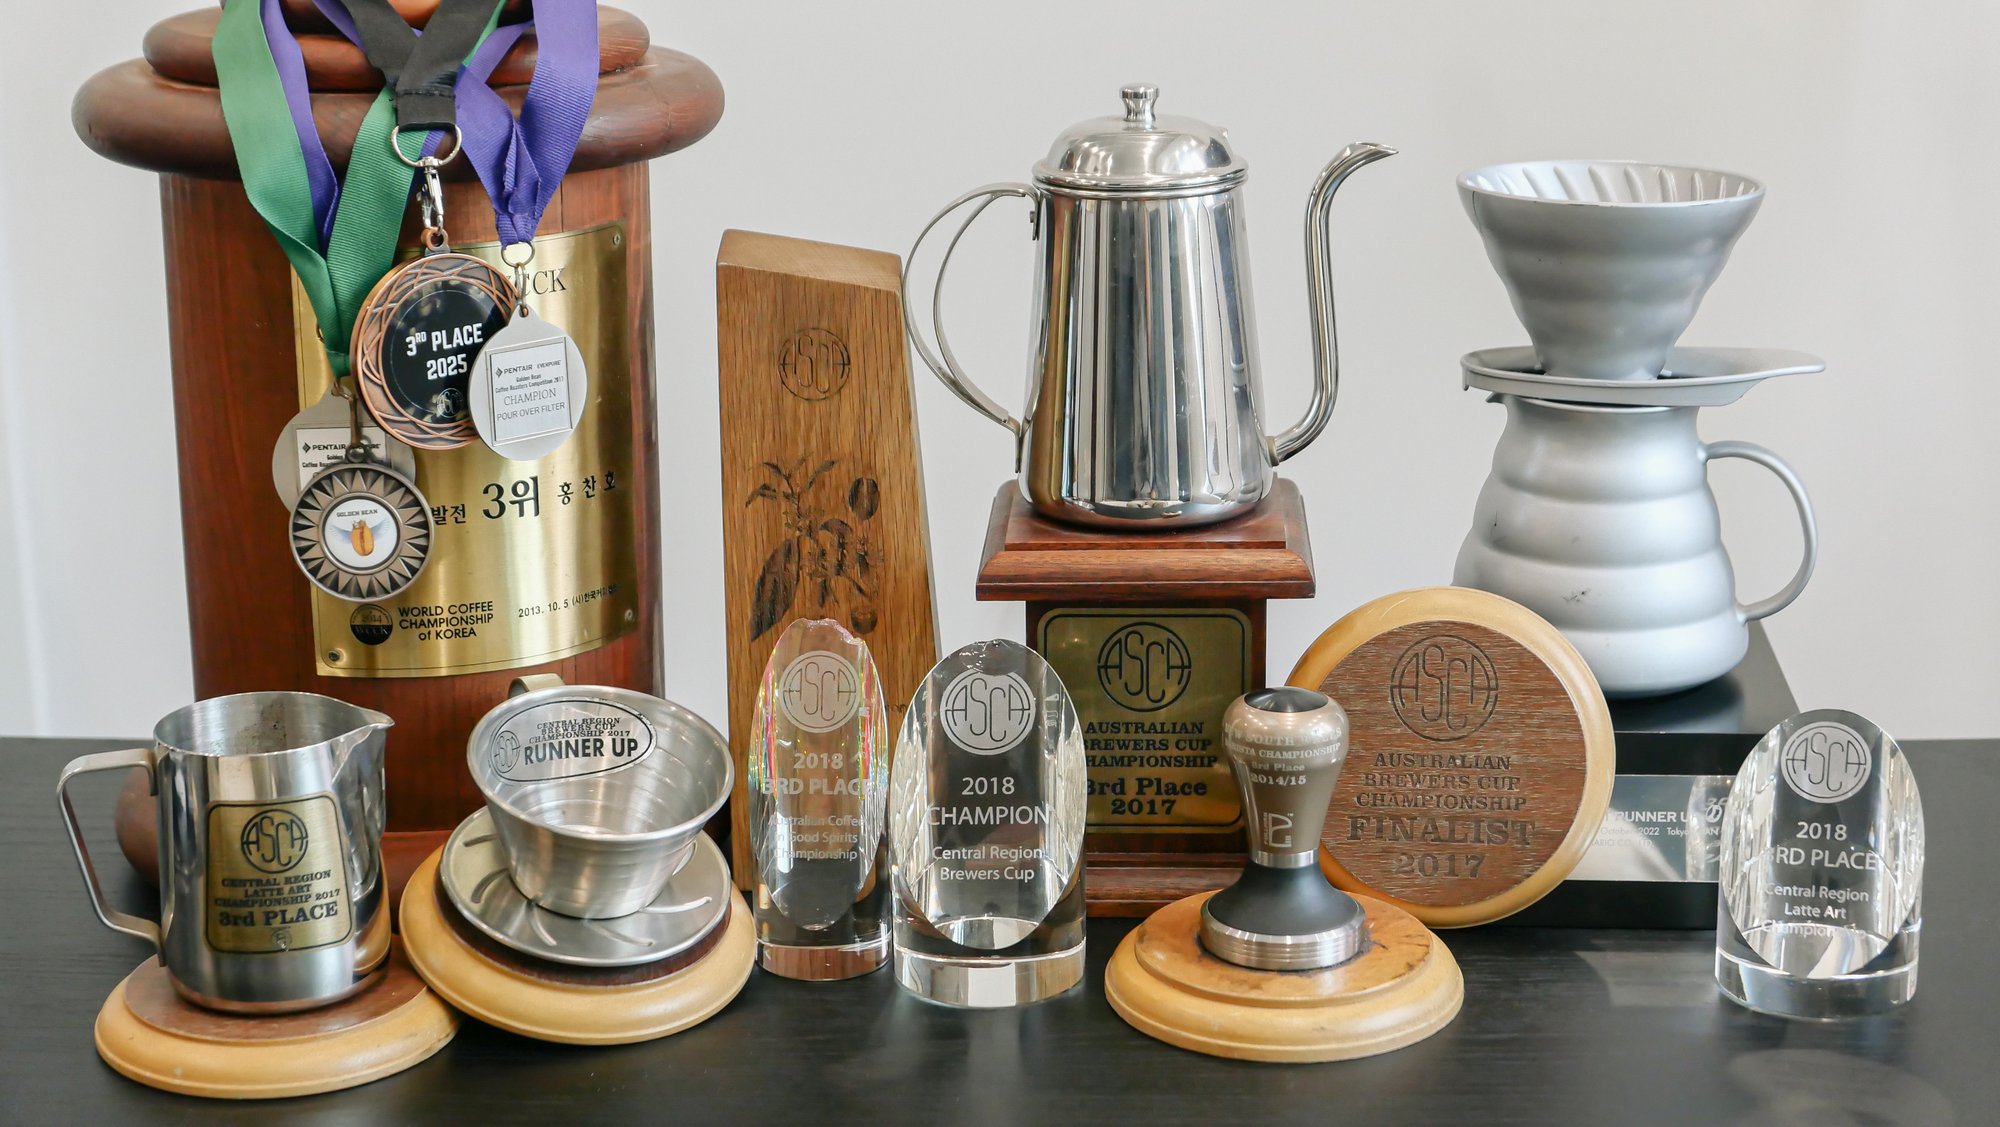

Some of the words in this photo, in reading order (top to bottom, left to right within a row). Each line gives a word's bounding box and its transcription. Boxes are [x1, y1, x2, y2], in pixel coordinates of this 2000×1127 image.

[431, 323, 484, 352] PLACE
[426, 353, 468, 380] 2025
[504, 364, 533, 374] PENTAIR
[504, 388, 556, 406] CHAMPION
[496, 411, 518, 421] POUR
[519, 407, 540, 417] OVER
[541, 402, 565, 412] FILTER
[482, 475, 540, 520] 3위
[398, 605, 444, 618] WORLD
[448, 601, 493, 615] COFFEE
[518, 606, 544, 618] 2013.
[548, 601, 560, 612] 10.
[564, 598, 569, 609] 5
[399, 613, 494, 630] CHAMPIONSHIP
[418, 630, 431, 641] of
[435, 627, 476, 640] KOREA
[1097, 629, 1192, 704] ASCA
[783, 660, 858, 722] ASCA
[1390, 644, 1499, 731] ASCA
[944, 677, 1031, 743] ASCA
[537, 718, 578, 730] CENTRAL
[582, 717, 621, 725] REGION
[541, 724, 592, 736] BREWERS
[595, 723, 616, 731] CUP
[1084, 721, 1205, 734] AUSTRALIAN
[529, 730, 604, 745] CHAMPIONSHIP
[608, 730, 631, 738] 2017
[1174, 738, 1213, 752] CUP
[1246, 733, 1295, 746] SOUTH
[524, 738, 605, 766] RUNNER
[612, 738, 639, 758] UP
[1259, 742, 1341, 759] CHAMPIONSHIP
[793, 752, 844, 770] 2018
[1086, 755, 1218, 768] HAMPIONSHIP
[1274, 762, 1305, 772] Place
[1374, 752, 1512, 771] AUSTRALIAN
[1785, 731, 1867, 793] ASCA
[763, 777, 804, 796] 3RD
[961, 776, 1015, 796] 2018
[1087, 778, 1126, 796] 3rd
[1135, 777, 1208, 796] Place
[1250, 774, 1307, 786] 2014/15
[1362, 772, 1471, 790] BREWERS
[1477, 774, 1522, 791] CUP
[1111, 798, 1177, 816] 2017
[1355, 792, 1528, 811] CHAMPIONSHIP
[927, 805, 1051, 826] CHAMPION
[1614, 811, 1678, 823] RUNNER
[241, 810, 309, 870] ASCA
[822, 832, 858, 847] Spirits
[1346, 815, 1536, 846] FINALIST
[1796, 821, 1848, 841] 2018
[932, 846, 986, 860] Central
[990, 845, 1043, 863] Region
[1810, 848, 1878, 871] PLACE
[940, 866, 1000, 881] Brewers
[1003, 866, 1036, 884] Cup
[1393, 853, 1486, 879] 2017
[222, 878, 282, 888] CENTRAL
[284, 870, 332, 885] REGION
[215, 894, 312, 908] CHAMPIONSHIP
[315, 888, 341, 901] 2017
[244, 886, 284, 898] LATTE
[288, 883, 313, 894] ART
[1765, 882, 1816, 898] Central
[1819, 886, 1870, 904] Region
[218, 911, 256, 927] 3rd
[262, 901, 339, 926] PLACE
[1784, 902, 1821, 917] Latte
[1824, 905, 1847, 920] Art
